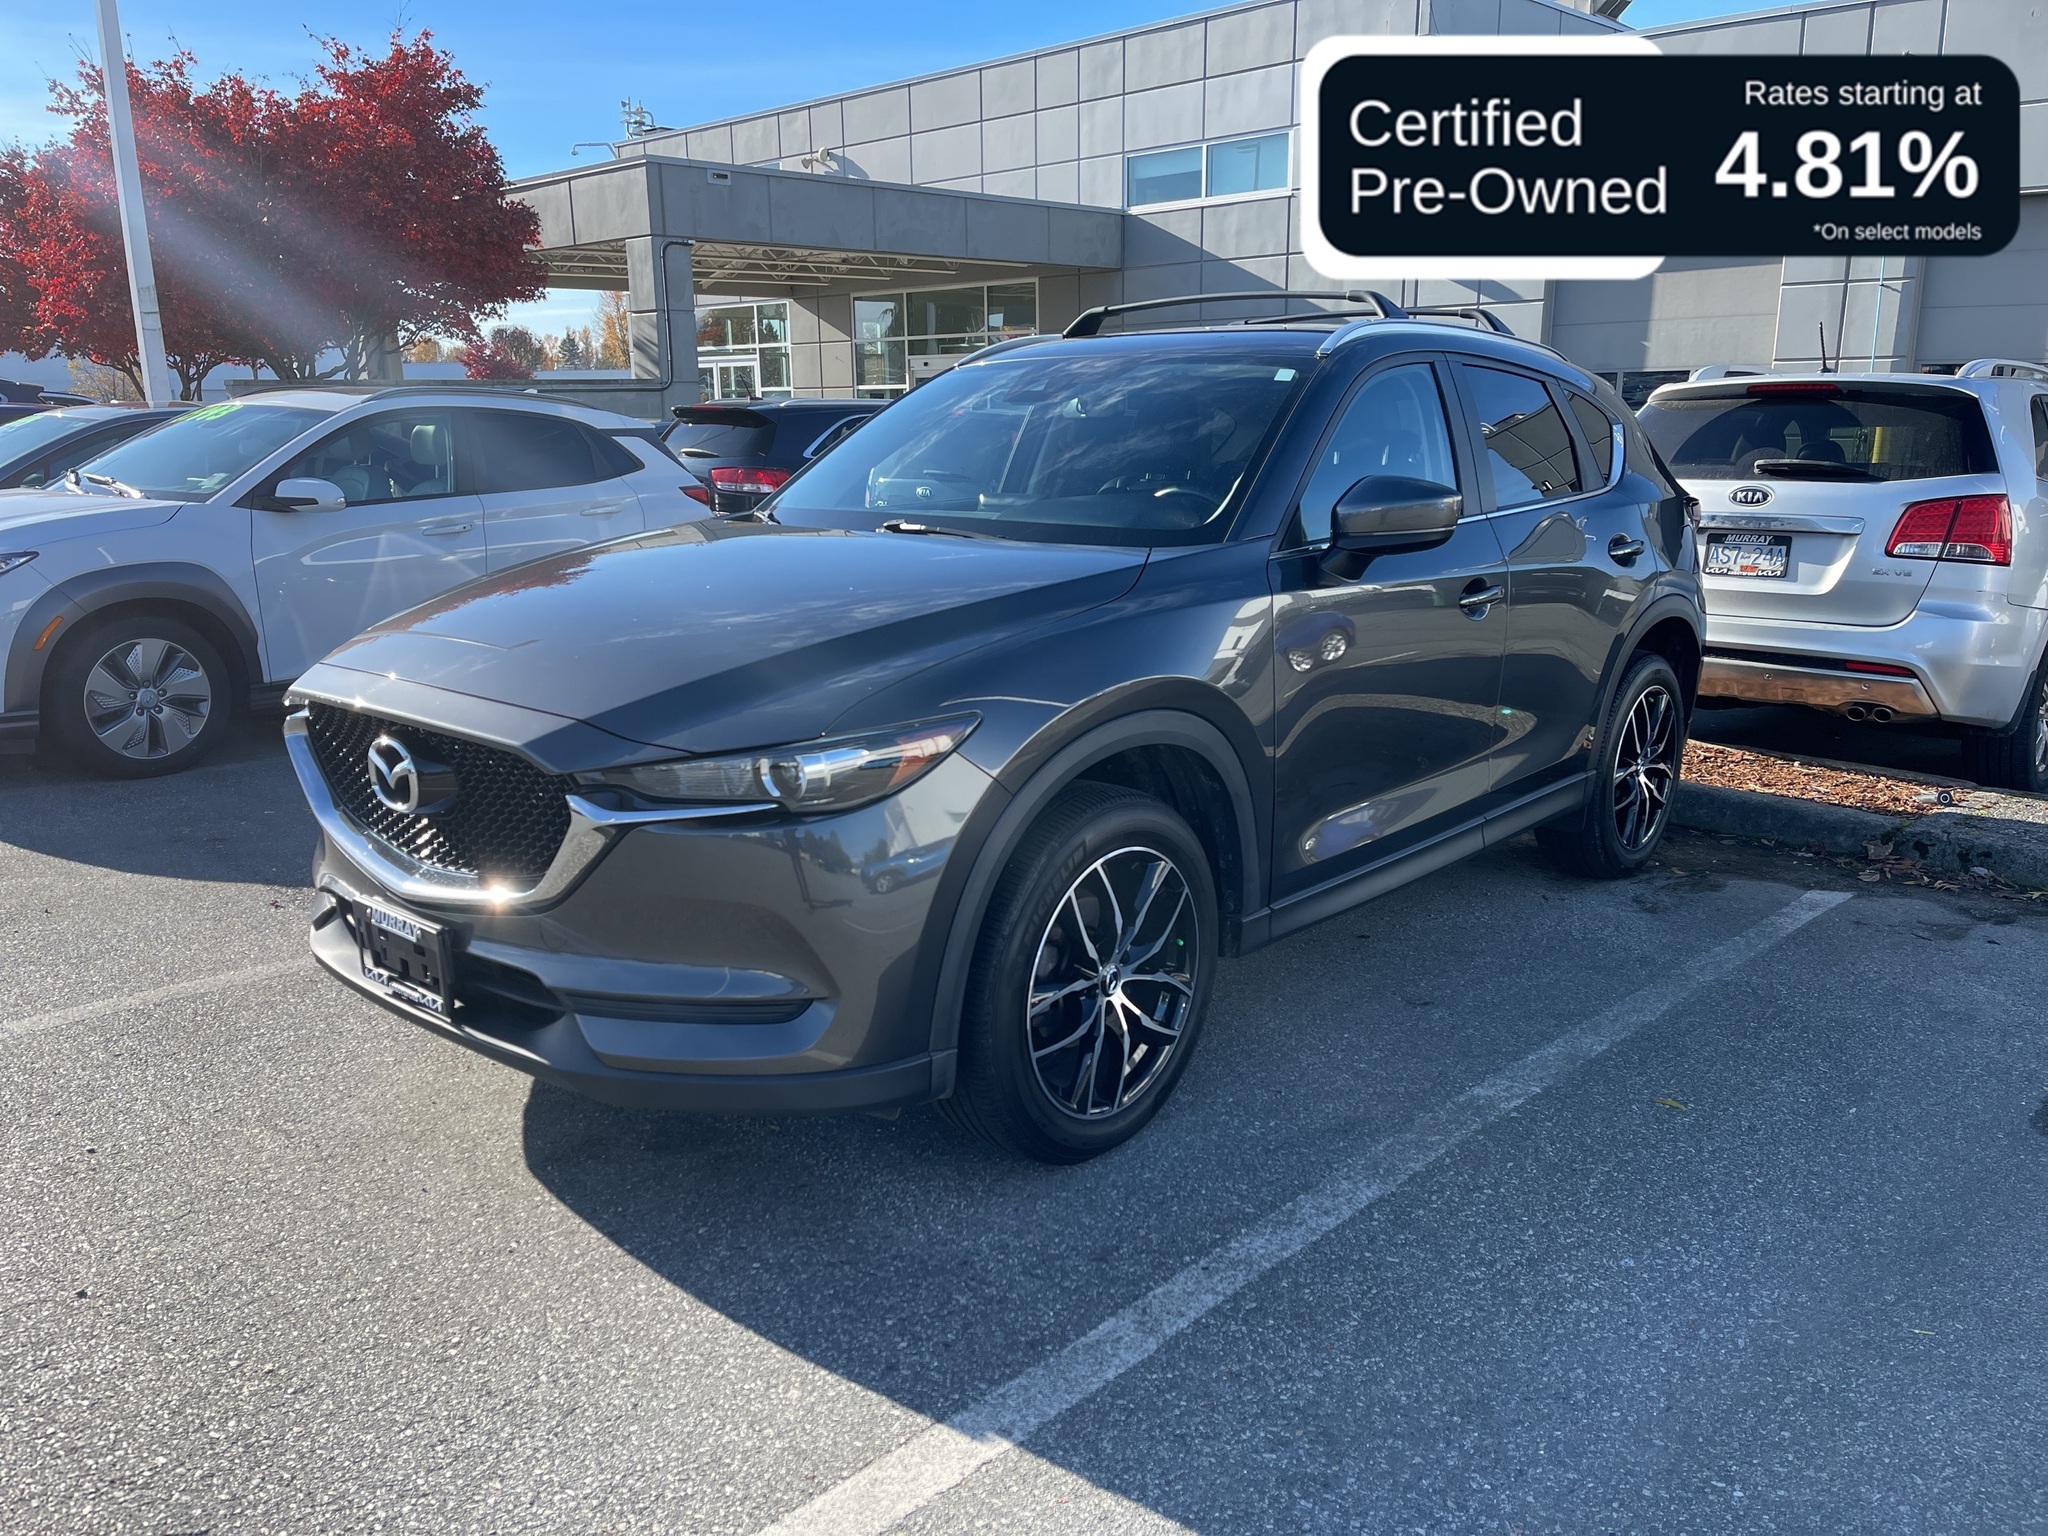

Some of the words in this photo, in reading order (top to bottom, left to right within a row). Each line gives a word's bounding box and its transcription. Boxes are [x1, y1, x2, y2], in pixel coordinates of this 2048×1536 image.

[1736, 491, 1765, 502] KIA
[1725, 534, 1774, 544] MURRAY
[371, 907, 418, 938] MURRAY
